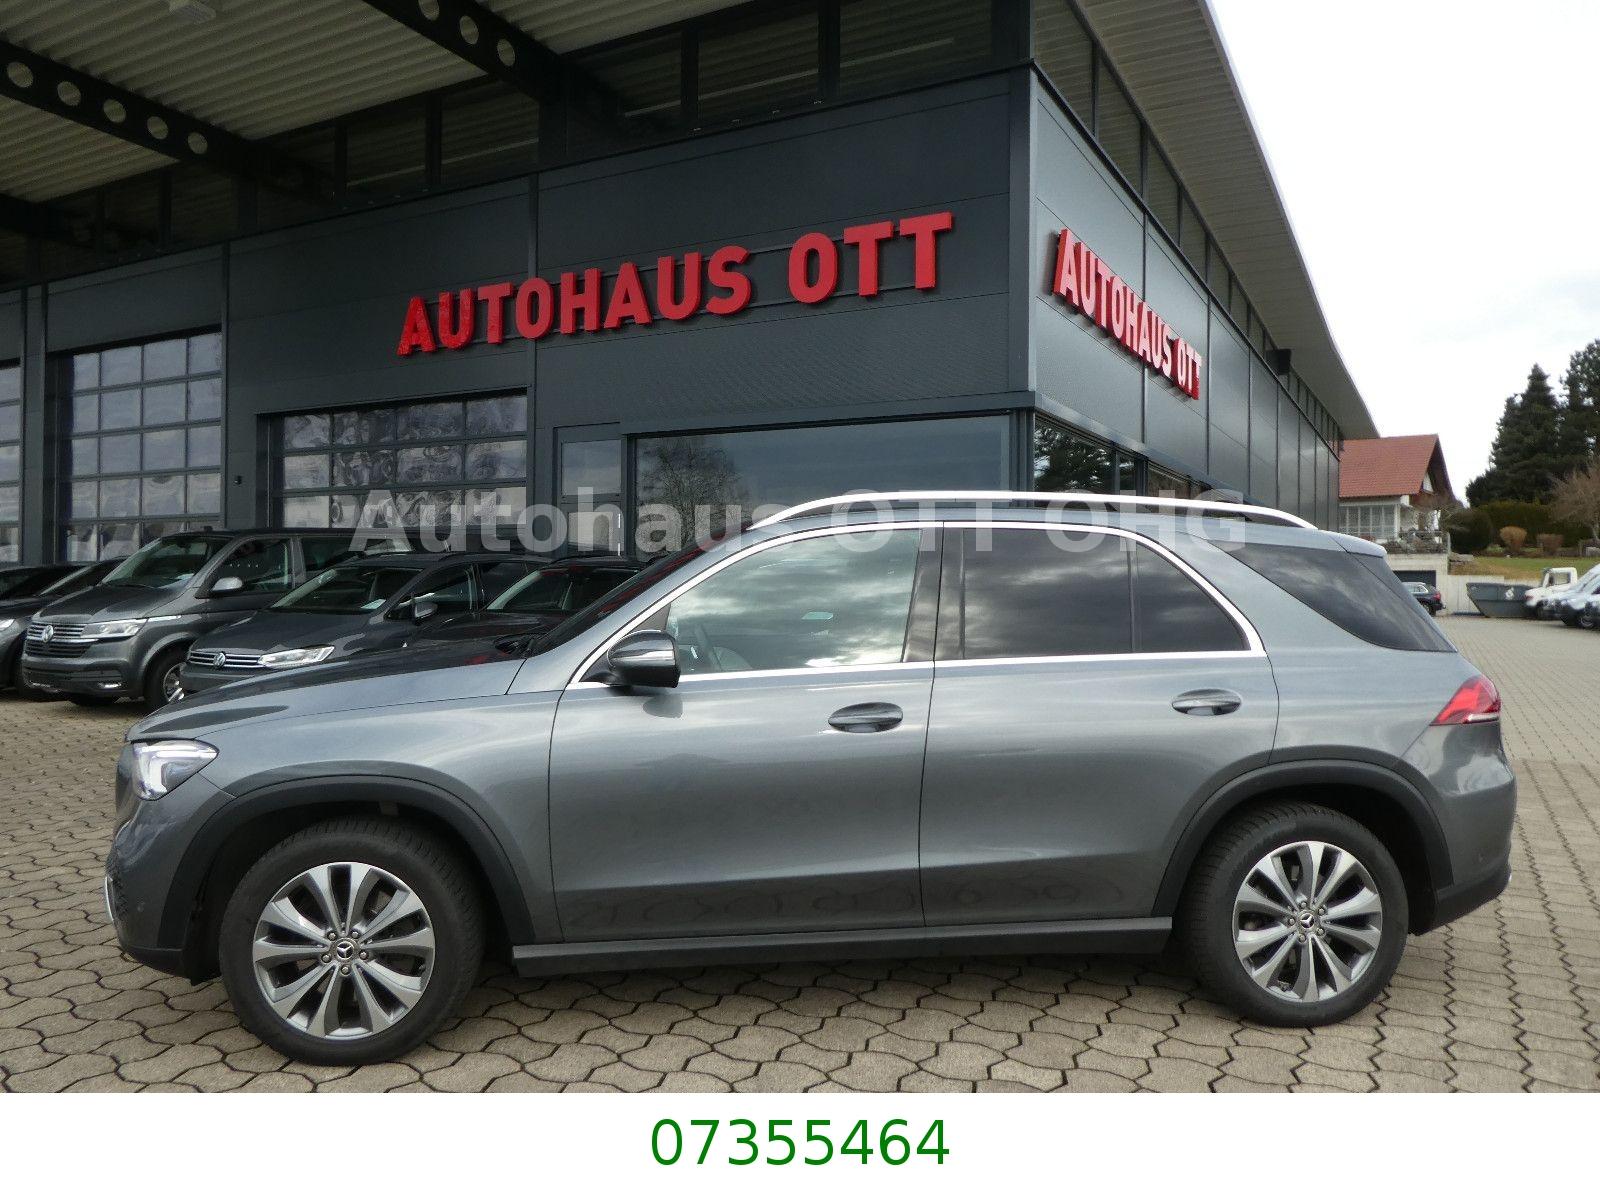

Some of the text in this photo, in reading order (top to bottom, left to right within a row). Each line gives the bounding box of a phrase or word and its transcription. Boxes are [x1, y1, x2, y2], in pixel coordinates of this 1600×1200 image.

[397, 212, 953, 356] AUTOHAUS OTT
[1053, 228, 1202, 400] AUTOHAUS OTT
